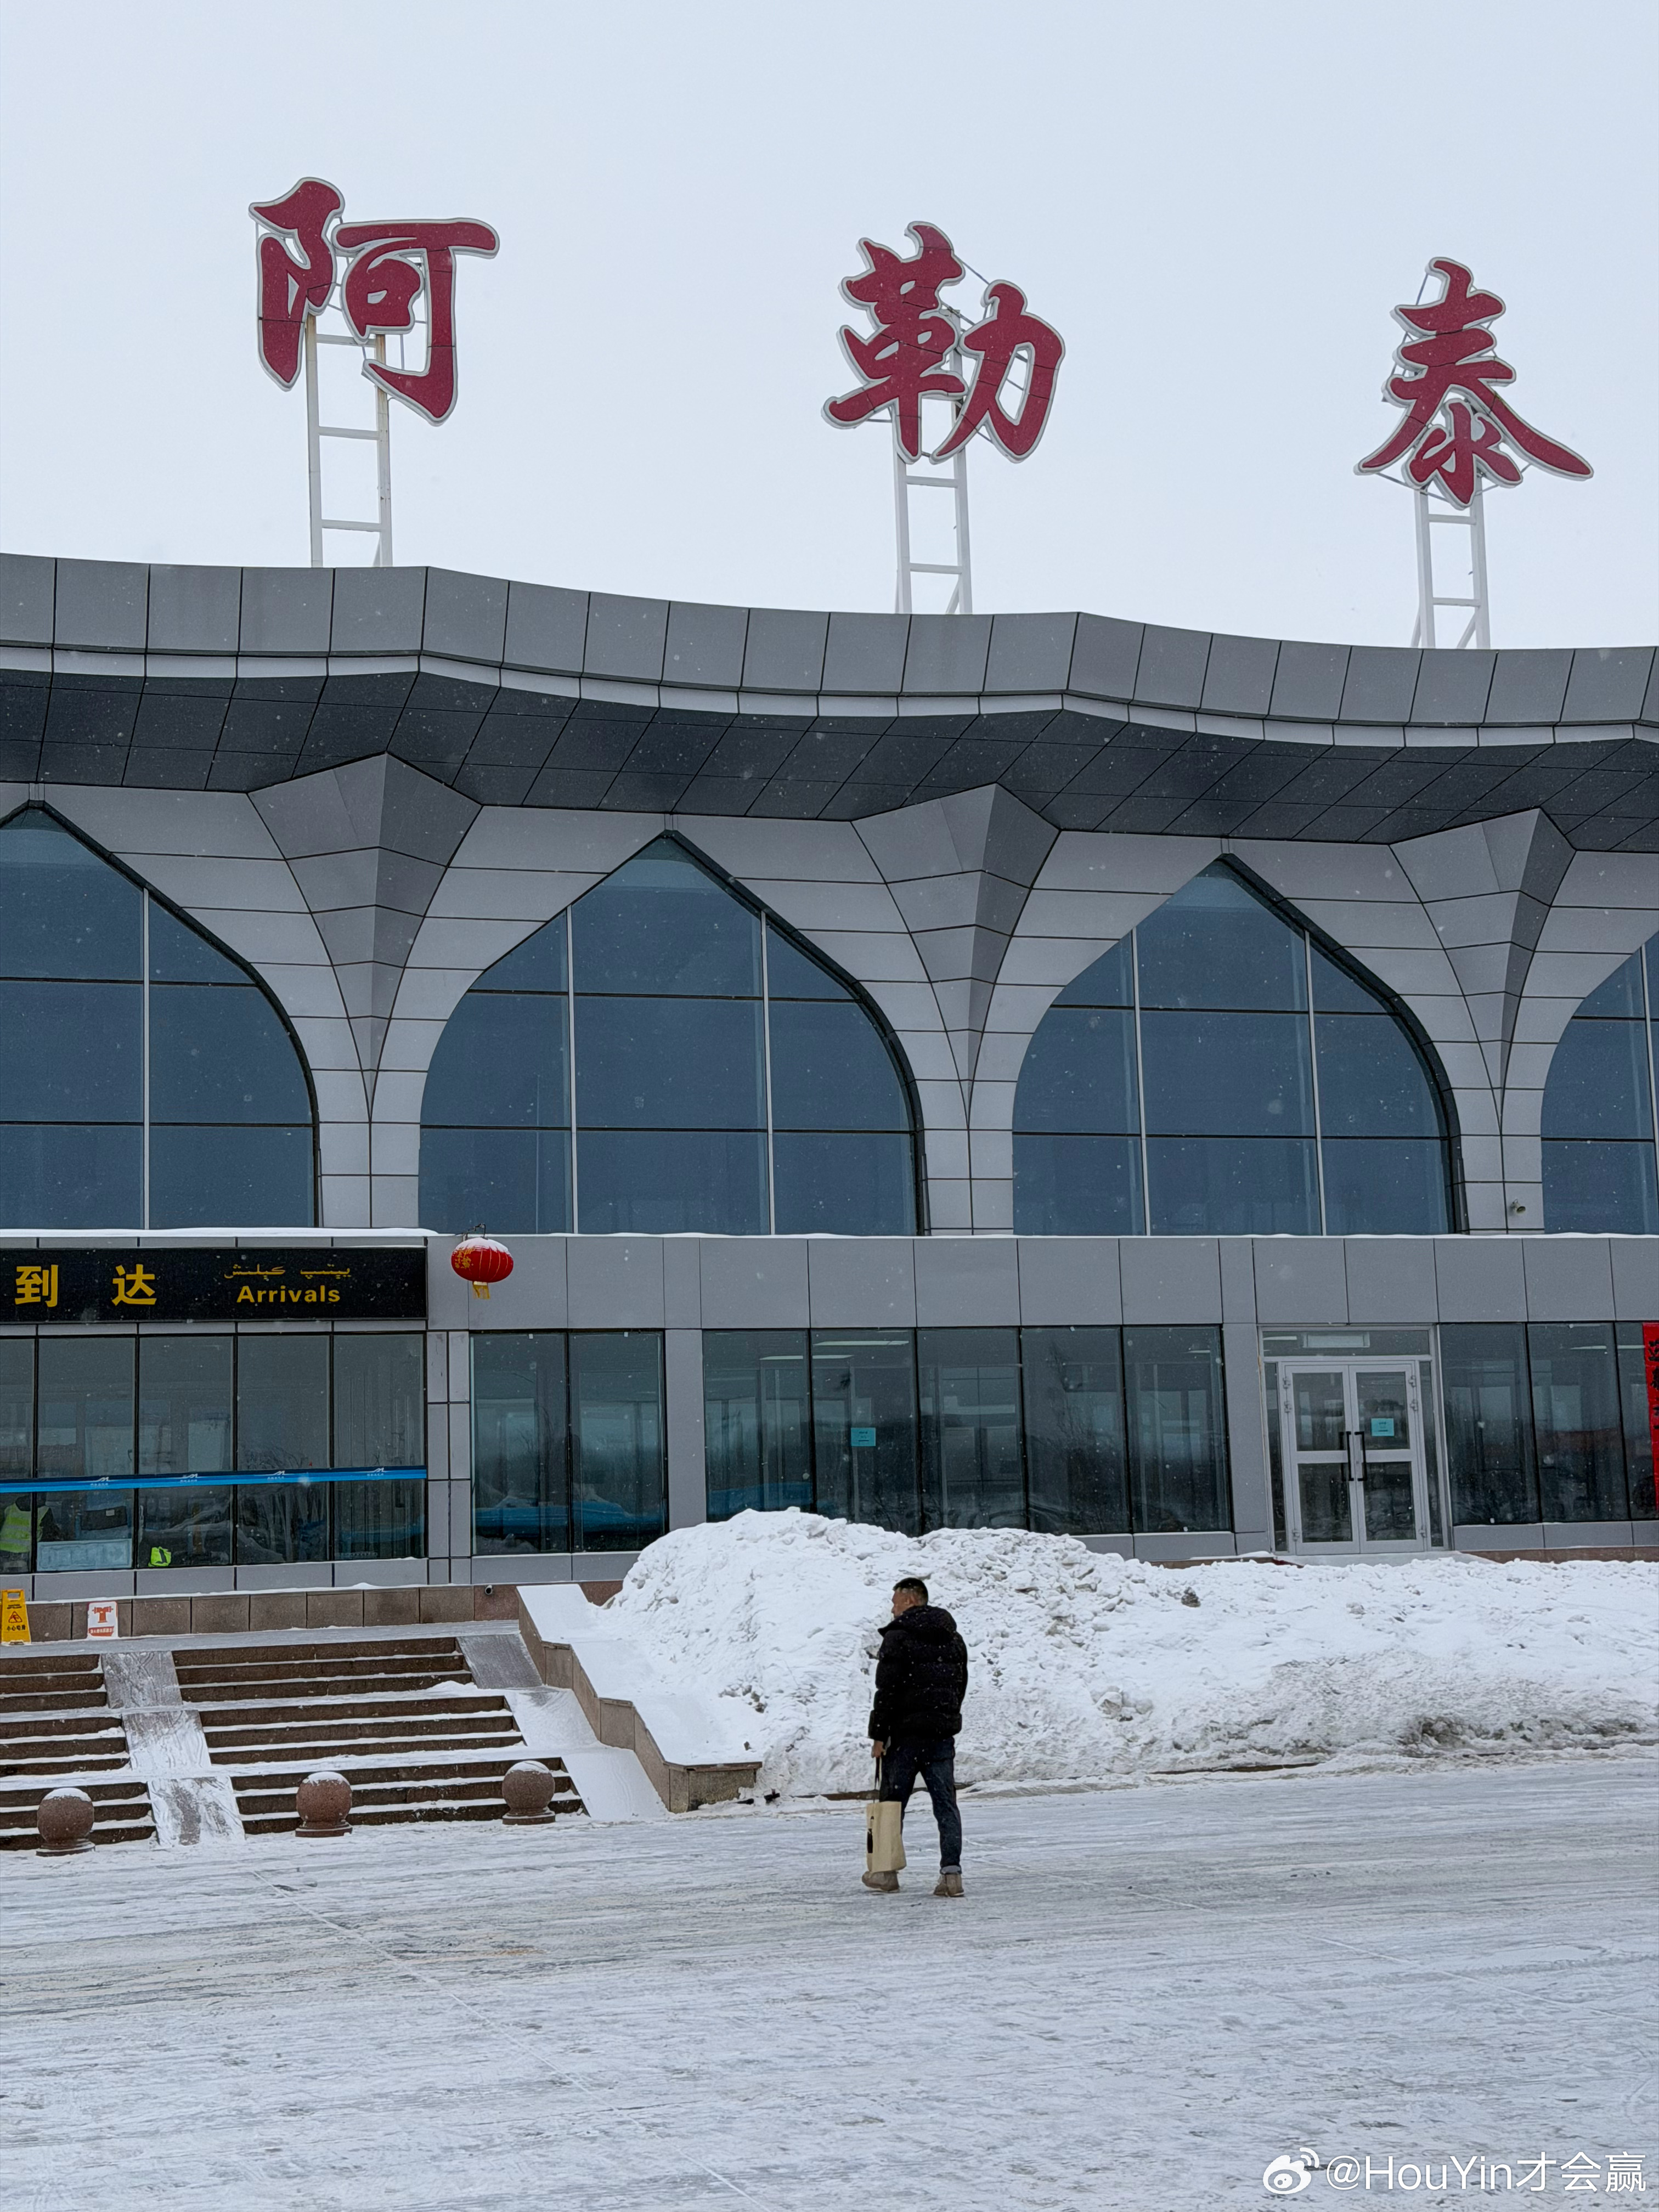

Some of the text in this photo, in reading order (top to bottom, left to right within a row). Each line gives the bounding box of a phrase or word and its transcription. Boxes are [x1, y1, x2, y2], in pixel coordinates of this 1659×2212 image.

[249, 177, 1594, 511] 阿勒泰
[15, 1264, 157, 1307] 到达
[236, 1285, 341, 1303] Arrivals
